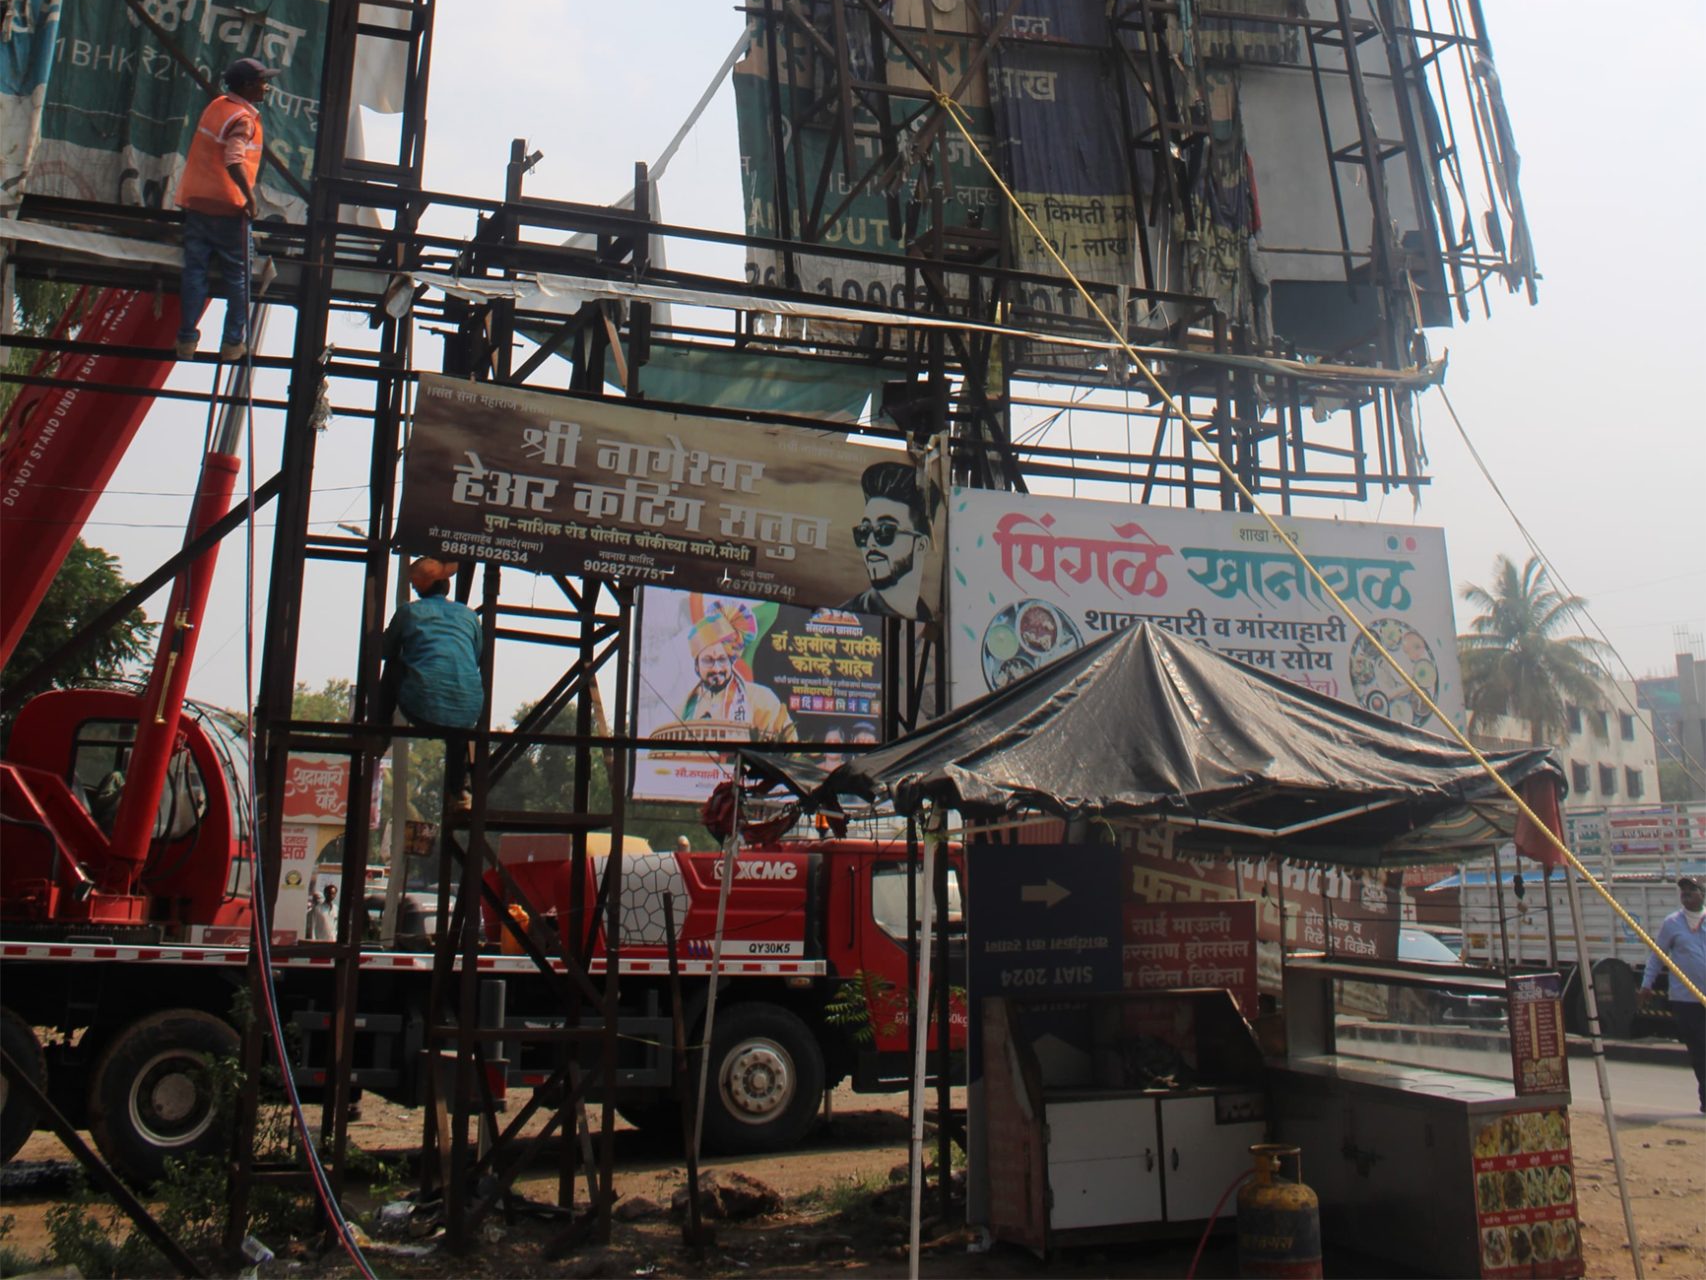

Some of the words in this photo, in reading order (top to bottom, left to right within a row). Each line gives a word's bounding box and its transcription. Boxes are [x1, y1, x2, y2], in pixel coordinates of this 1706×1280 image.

[15, 461, 36, 487] NOT
[30, 418, 61, 460] STAND
[521, 420, 583, 468] श्री
[597, 433, 767, 495] नागेश्वर
[452, 450, 560, 513] हेअर
[573, 478, 706, 534] कटिंग
[564, 521, 588, 540] रोड
[590, 523, 631, 546] पोलीस
[1238, 527, 1270, 543] शाखा
[440, 540, 529, 565] 9881502634
[992, 512, 1175, 600] पिंगळे
[1179, 547, 1416, 614] खानावळ
[583, 559, 667, 581] 9028277751
[1213, 617, 1231, 638] व
[1236, 613, 1348, 645] मांसाहारी
[788, 652, 833, 677] कोल्हे
[834, 655, 875, 678] साहेब
[1281, 642, 1333, 671] सोय
[734, 860, 798, 880] XCMG
[748, 943, 791, 954] QY30K5
[1184, 936, 1250, 963] होलसेल
[1000, 966, 1047, 988] 2024
[1053, 966, 1094, 984] SIAT
